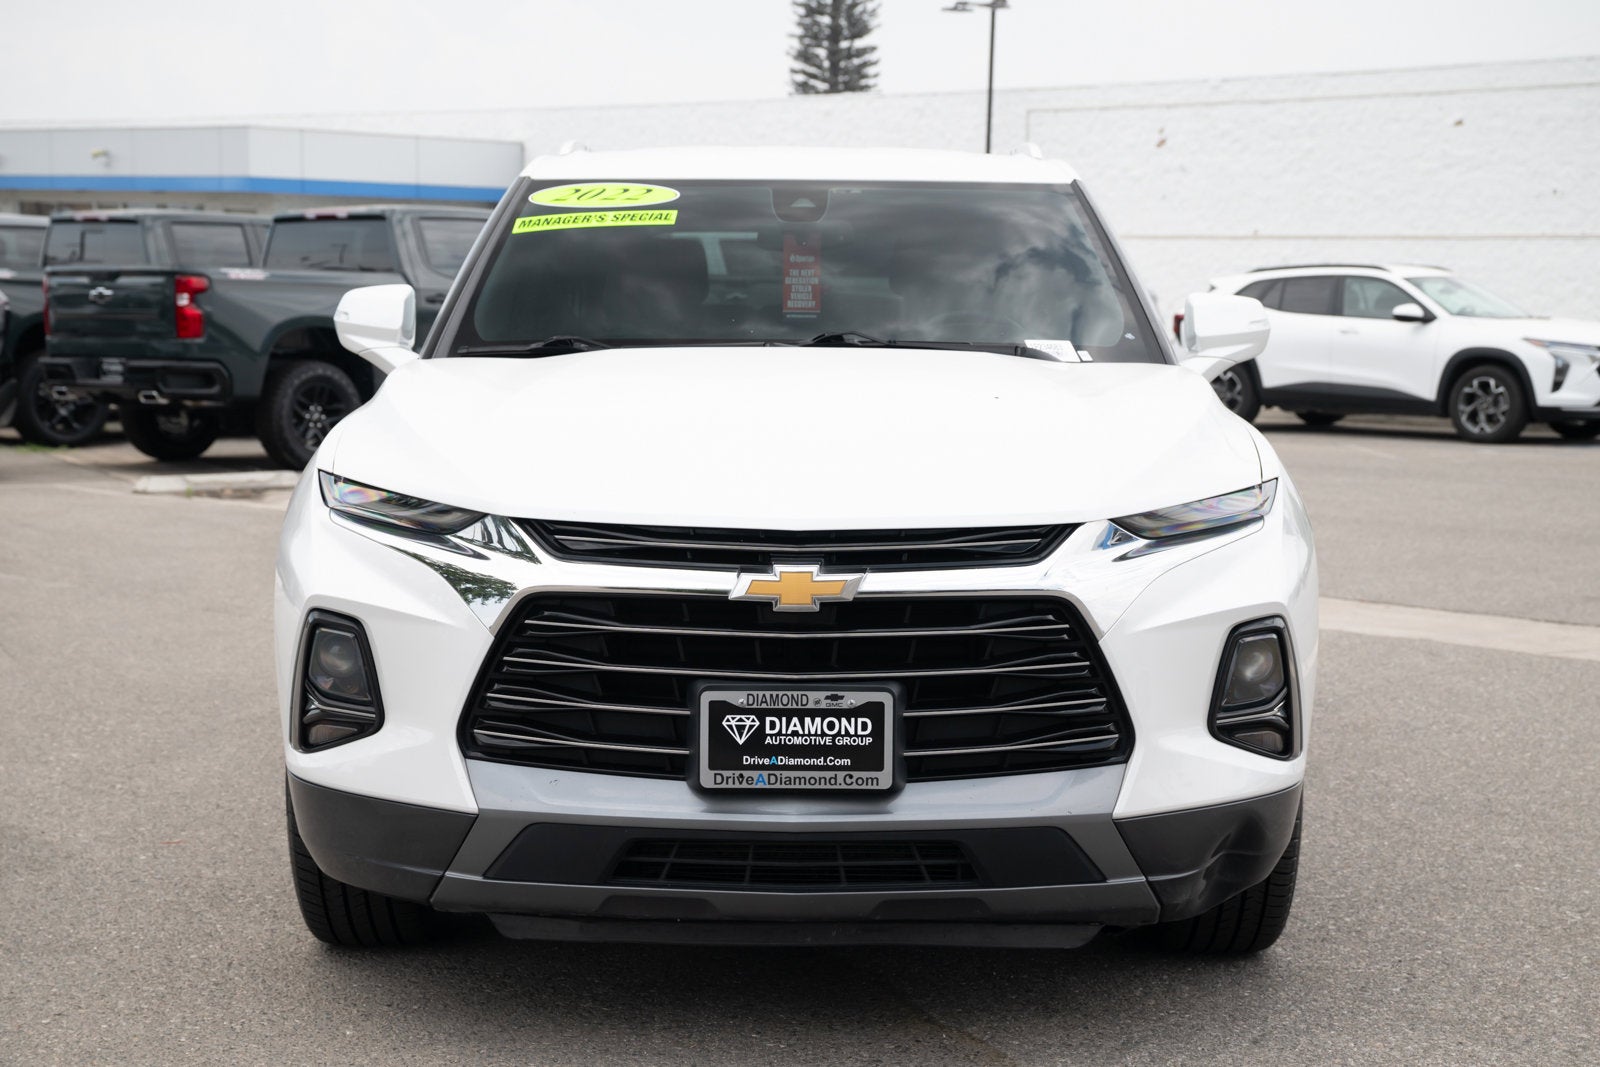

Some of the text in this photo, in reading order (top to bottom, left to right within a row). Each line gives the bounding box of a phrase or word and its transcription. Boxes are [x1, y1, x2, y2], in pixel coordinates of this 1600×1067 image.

[551, 188, 653, 202] 2022
[518, 212, 672, 229] MANAGER'S SPECIAL
[746, 693, 809, 707] DIAMOND
[765, 716, 873, 735] DIAMOND
[764, 736, 873, 746] AUTOMOTIVE GROUP
[743, 756, 851, 766] DriveADiamond.Com
[713, 772, 880, 787] DriveADiamond.Com
